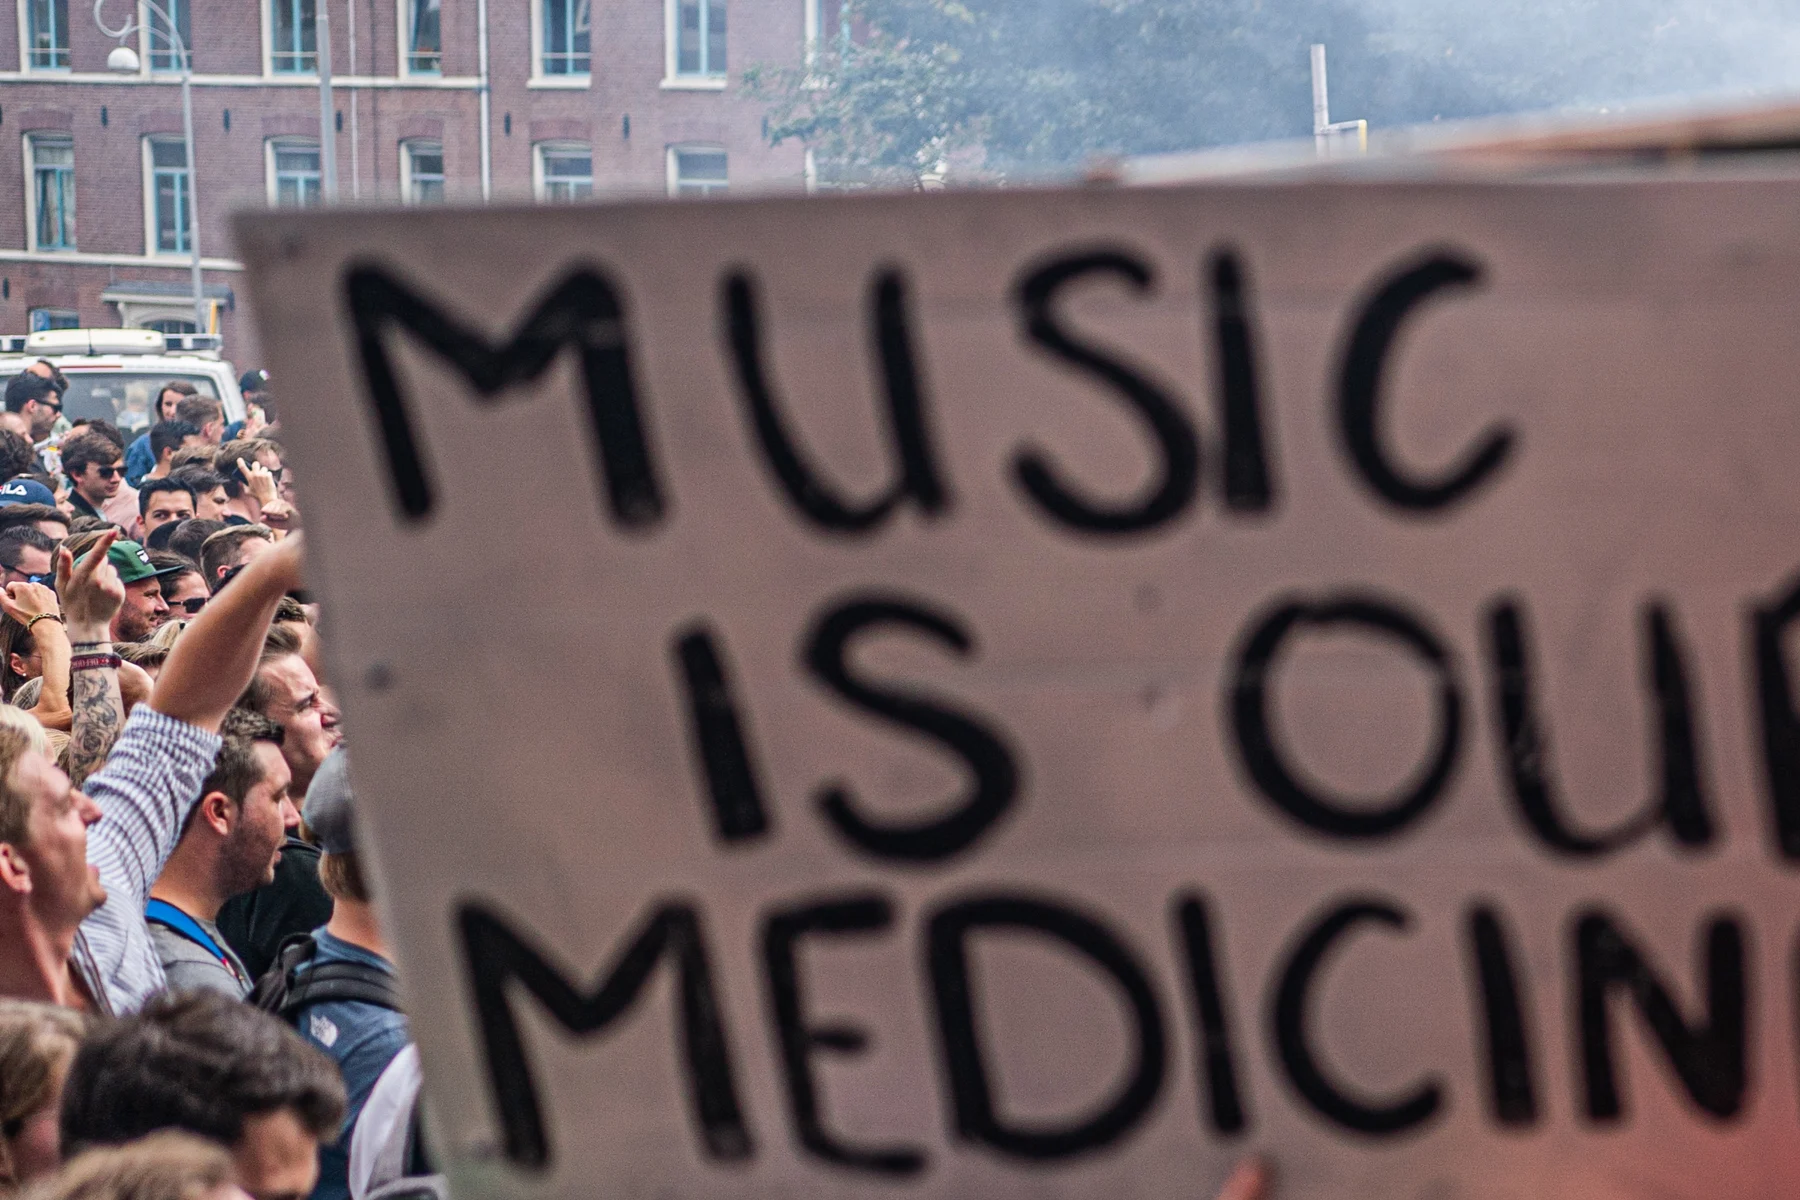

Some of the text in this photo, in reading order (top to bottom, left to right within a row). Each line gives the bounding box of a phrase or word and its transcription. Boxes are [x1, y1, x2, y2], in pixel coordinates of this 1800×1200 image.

[0, 484, 27, 496] ILA
[340, 242, 1518, 534] MUSIC
[671, 588, 1026, 864] IS
